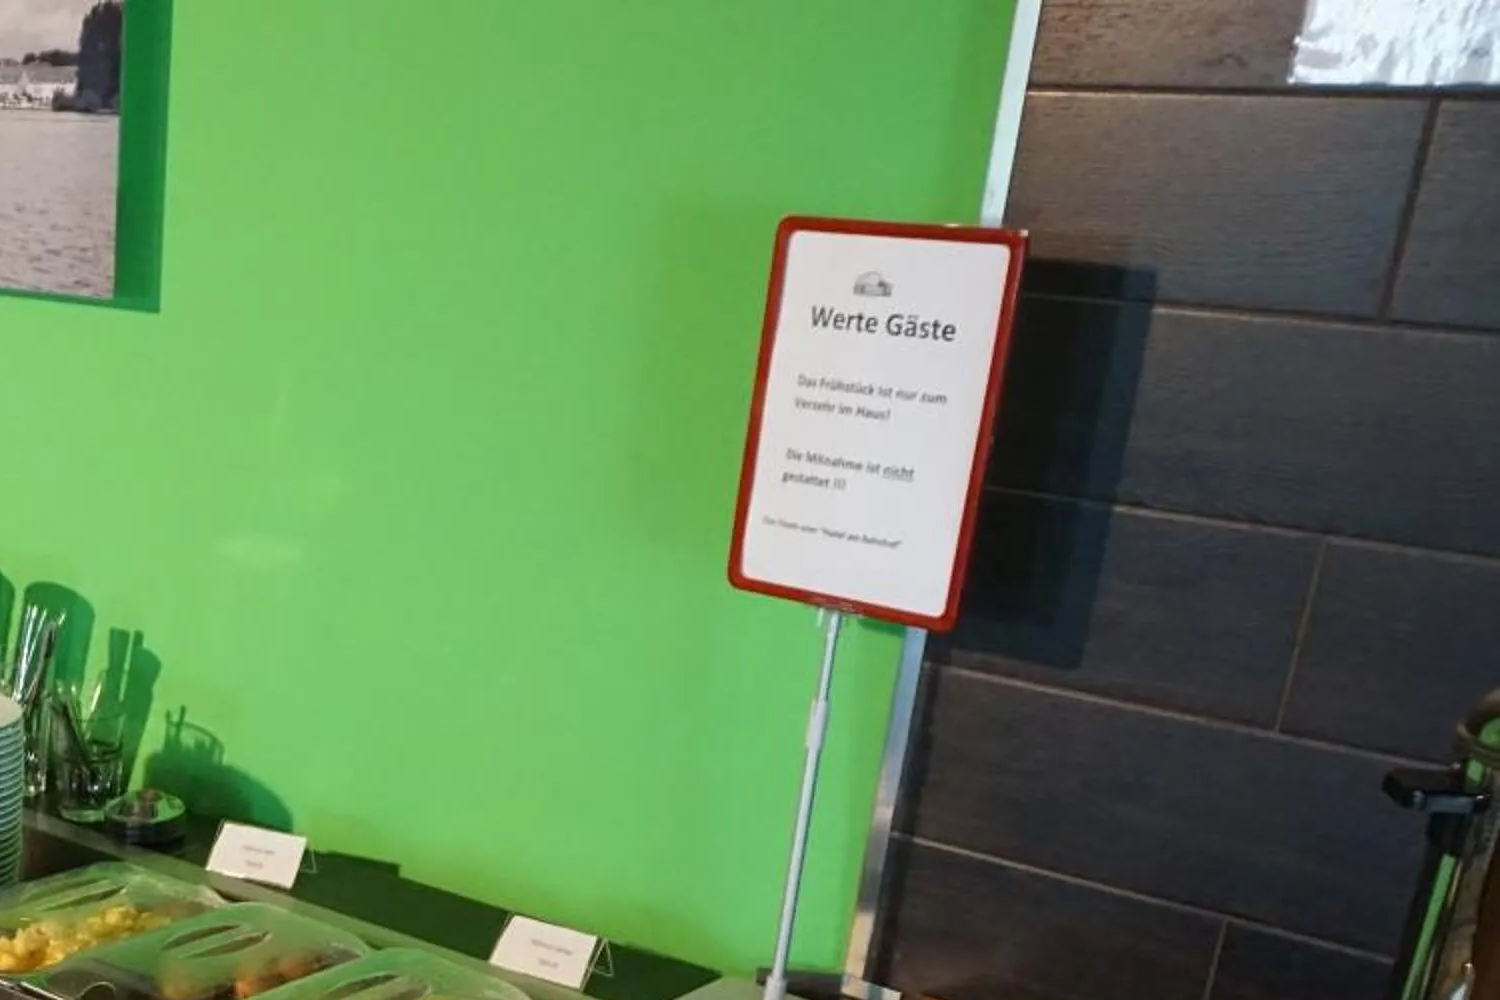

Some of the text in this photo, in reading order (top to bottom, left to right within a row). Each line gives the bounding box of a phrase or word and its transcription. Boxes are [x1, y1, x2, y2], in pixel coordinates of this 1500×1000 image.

[811, 304, 957, 342] Werte Gäste
[819, 376, 874, 395] Frühstück
[896, 390, 917, 401] nur
[920, 391, 947, 404] zum
[805, 450, 863, 471] Mitnahme
[882, 464, 915, 483] nicht
